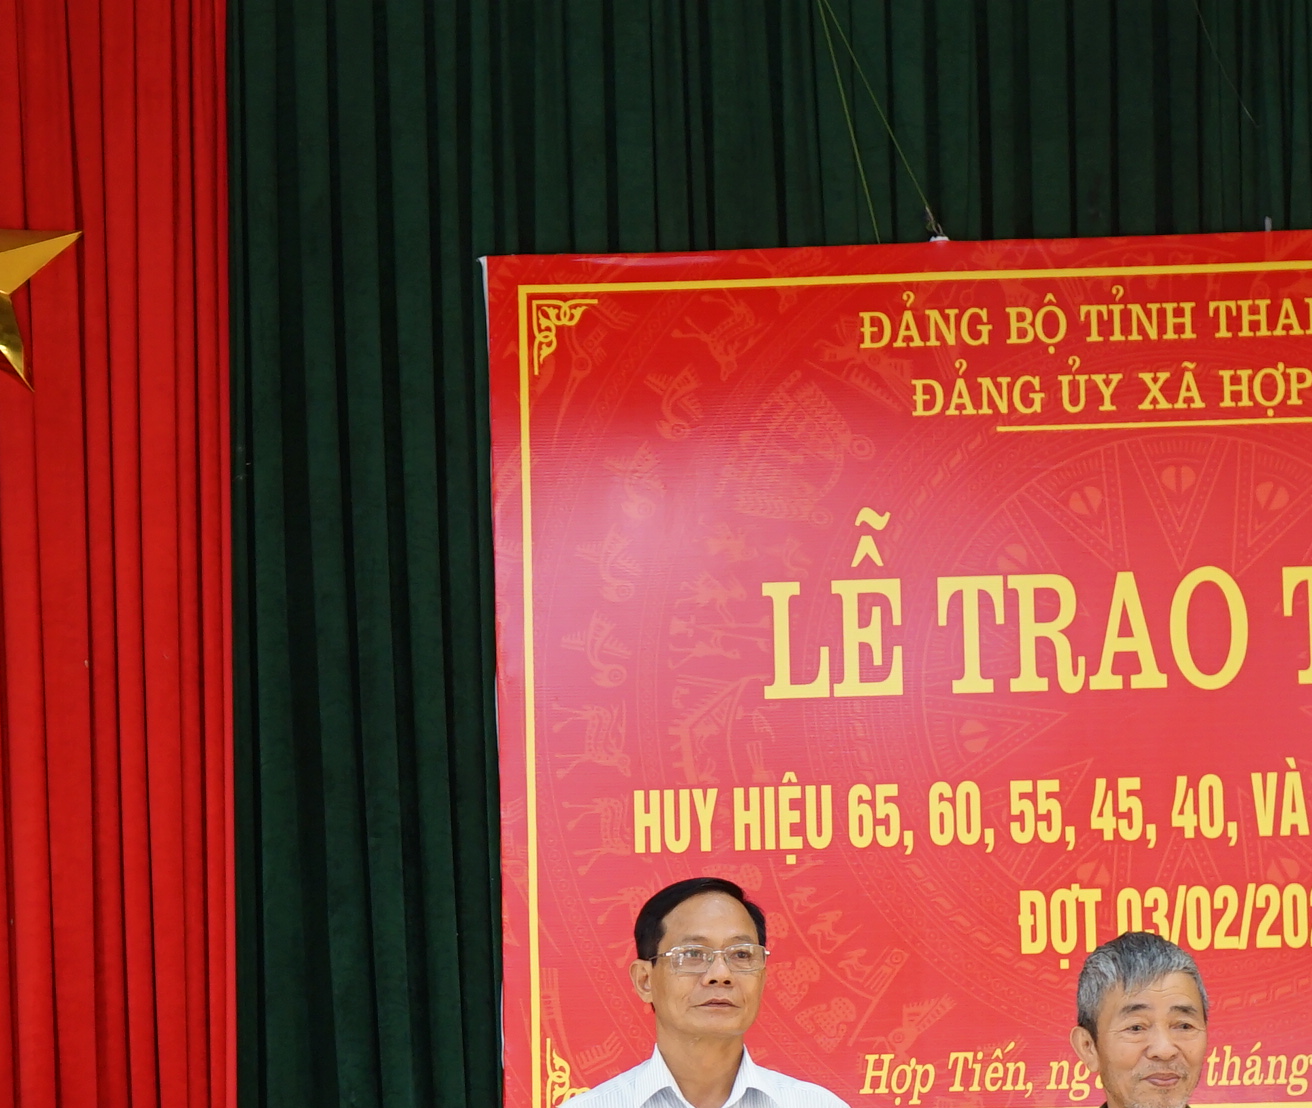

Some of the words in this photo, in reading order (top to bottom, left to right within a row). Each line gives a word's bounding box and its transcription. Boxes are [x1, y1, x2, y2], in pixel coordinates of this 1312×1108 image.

[858, 290, 992, 349] ĐẢNG
[1005, 293, 1067, 354] BỘ
[1080, 285, 1197, 342] TỈNH
[910, 359, 1045, 416] ĐẢNG
[1057, 355, 1123, 413] ỦY
[1138, 361, 1206, 410] XÃ
[1218, 362, 1312, 418] HỢP
[761, 507, 903, 700] LỄ
[937, 565, 1249, 694] TRAO
[633, 787, 718, 854] HUY
[733, 771, 833, 865] HIỆU
[847, 783, 914, 856] 65,
[928, 780, 995, 853] 60,
[1009, 779, 1076, 851] 55,
[1090, 776, 1157, 849] 45,
[1171, 773, 1238, 847] 40,
[1250, 756, 1310, 837] VÀ
[1017, 883, 1102, 970] ĐỢT
[860, 1052, 936, 1106] Hợp
[947, 1041, 1034, 1098] Tiến,
[1045, 1059, 1106, 1102] ng
